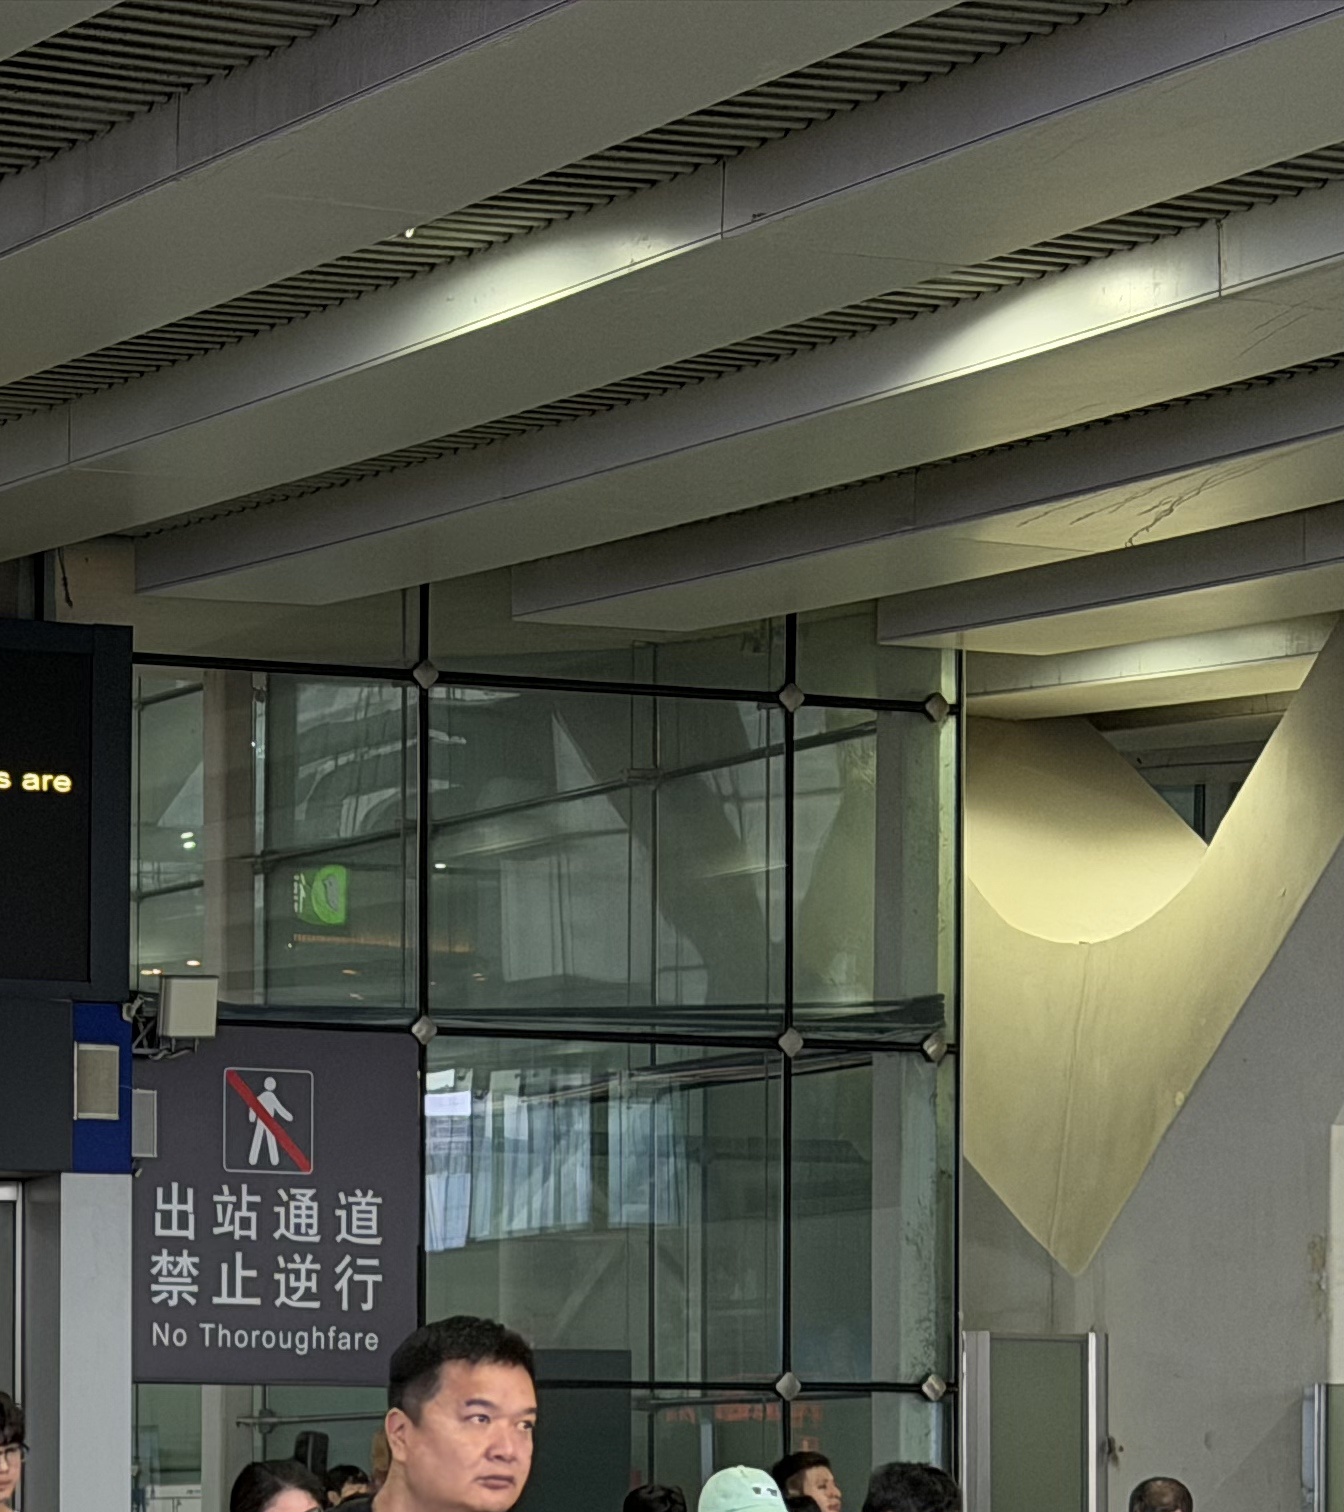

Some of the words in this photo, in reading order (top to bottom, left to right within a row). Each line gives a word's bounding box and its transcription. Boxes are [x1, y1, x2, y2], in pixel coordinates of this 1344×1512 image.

[22, 773, 71, 792] are
[155, 1182, 382, 1244] 出站通道
[150, 1249, 382, 1310] 禁止逆行
[153, 1322, 187, 1346] No
[199, 1323, 378, 1355] Thoroughfare
